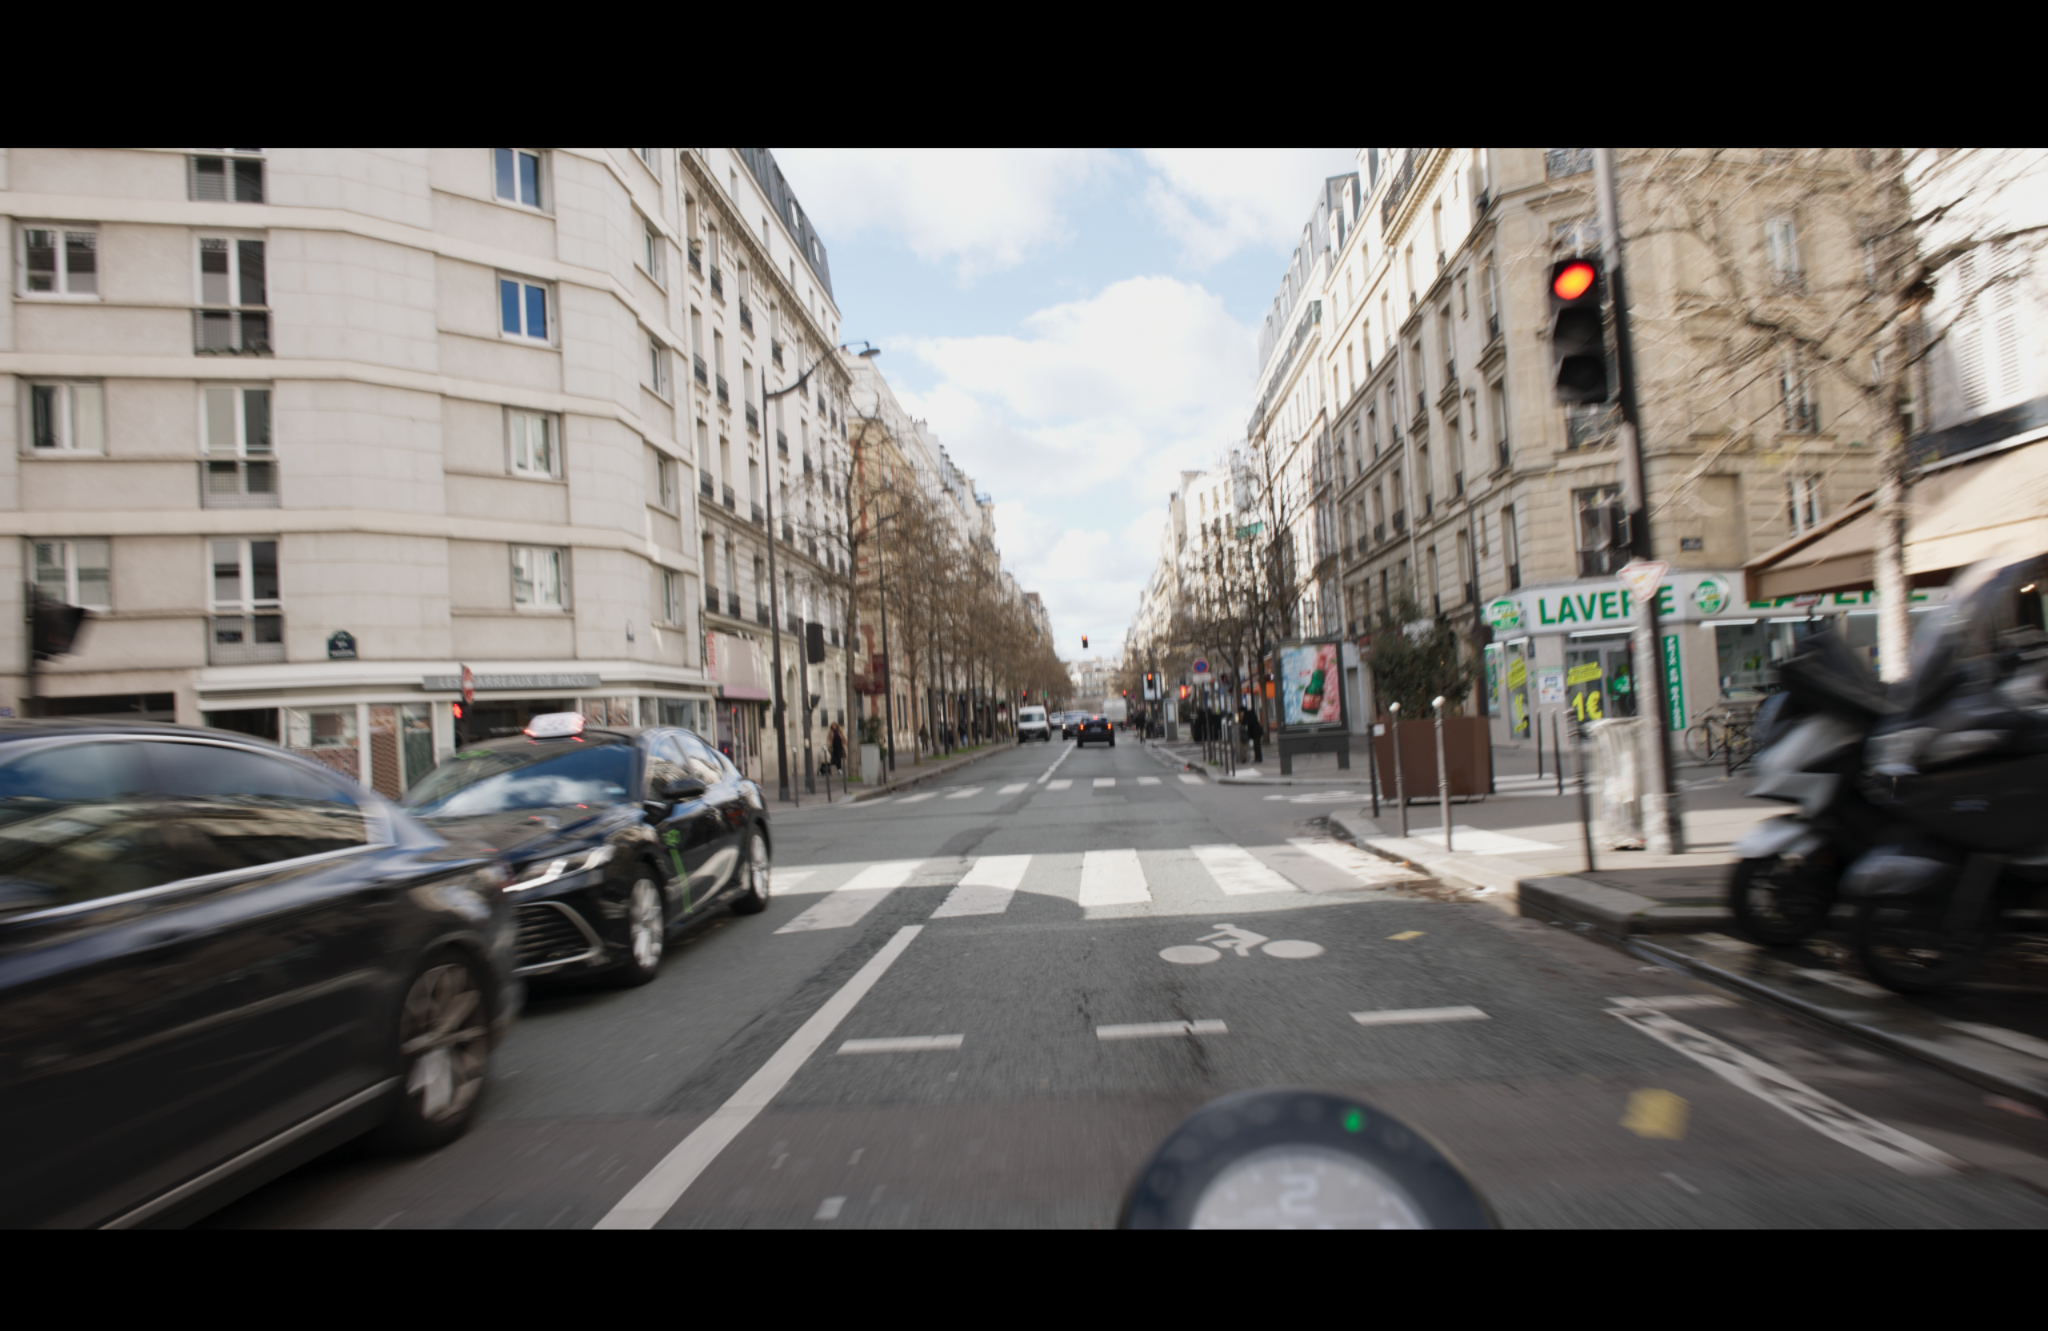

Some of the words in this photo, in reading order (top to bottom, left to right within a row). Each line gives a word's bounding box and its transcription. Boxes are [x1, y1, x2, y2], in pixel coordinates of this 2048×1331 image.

[1538, 585, 1675, 625] LAVEE
[439, 676, 461, 689] LES
[471, 675, 534, 689] ARREAUX
[538, 674, 553, 687] DE
